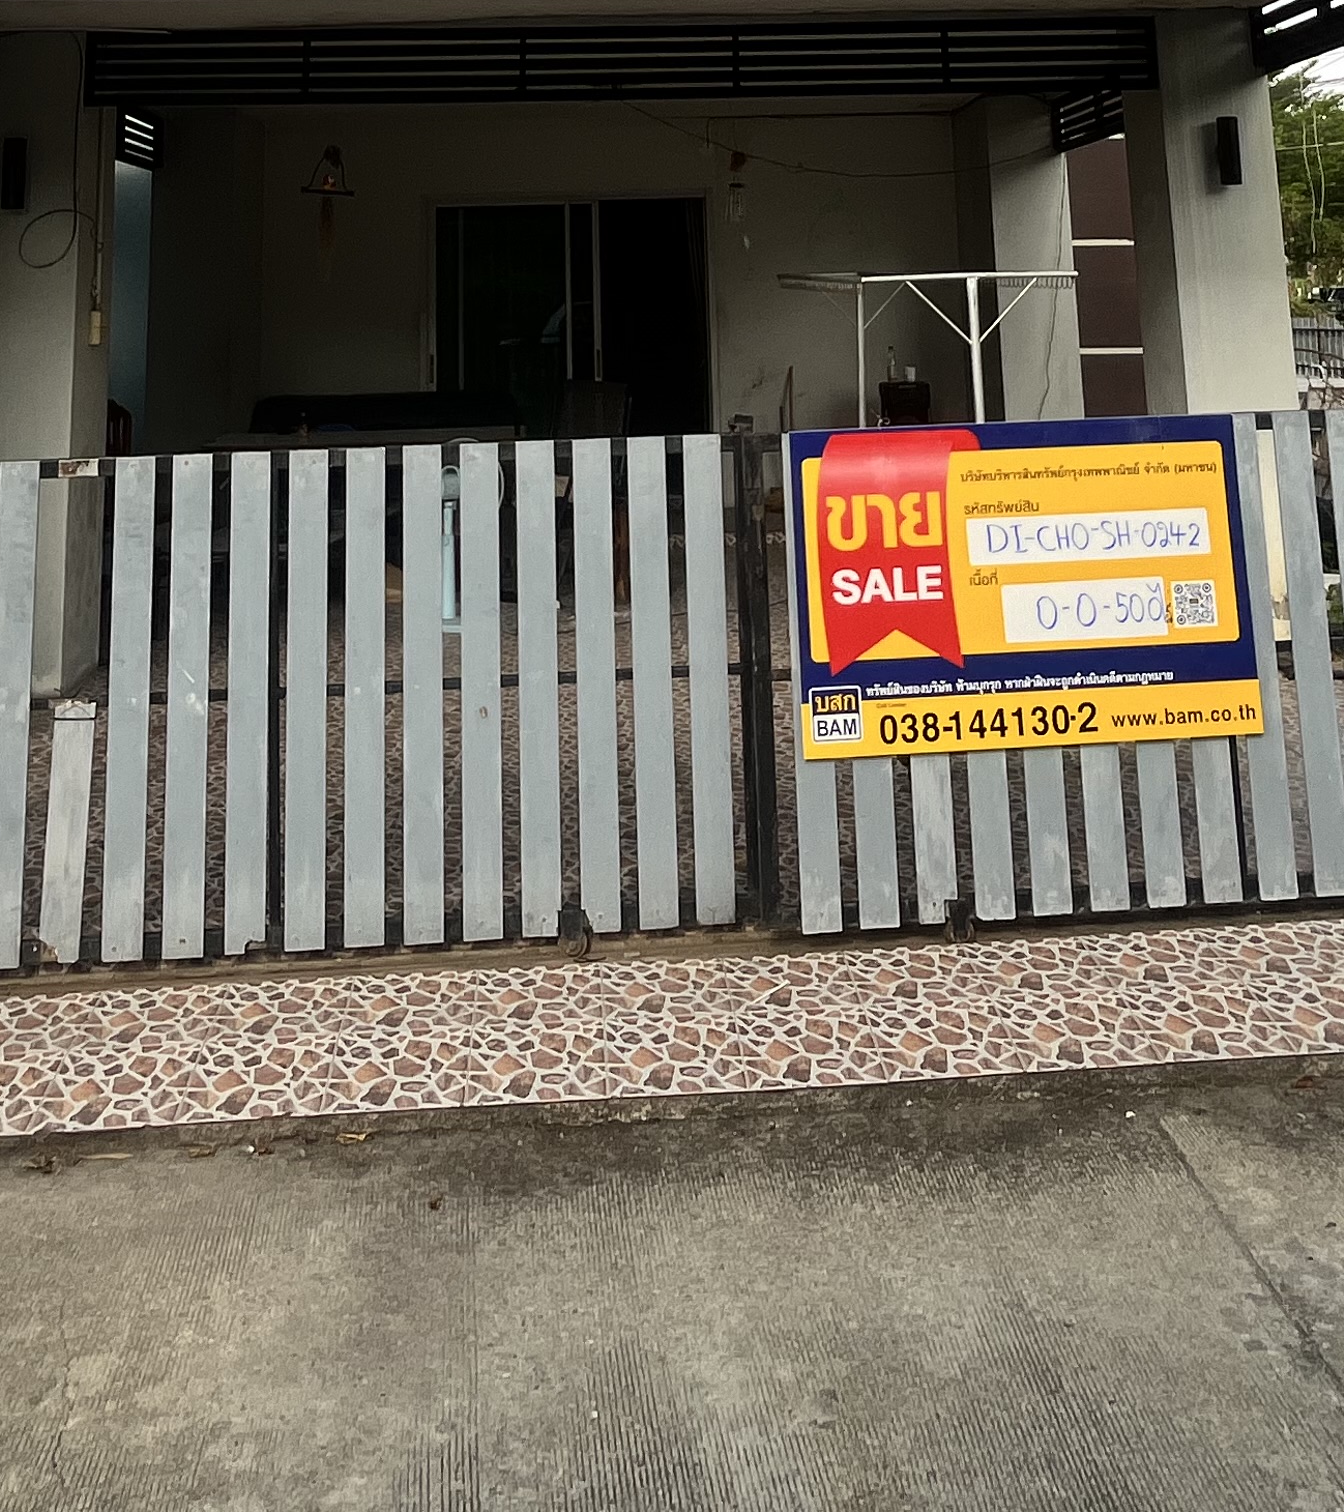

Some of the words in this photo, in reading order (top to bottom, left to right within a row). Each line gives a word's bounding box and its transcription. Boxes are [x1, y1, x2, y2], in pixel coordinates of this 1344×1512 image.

[1144, 462, 1170, 474] จำกัด
[1174, 462, 1217, 474] (มหาชน)
[964, 499, 1040, 515] รหัสทรัพย์สิน
[825, 491, 943, 552] ขาย
[832, 565, 944, 606] SALE
[969, 568, 999, 587] เนื้อที่
[815, 694, 856, 713] บสก
[817, 718, 857, 737] BAM
[879, 702, 1099, 745] 038-144130-2
[1111, 704, 1256, 728] www.bam.co.th
